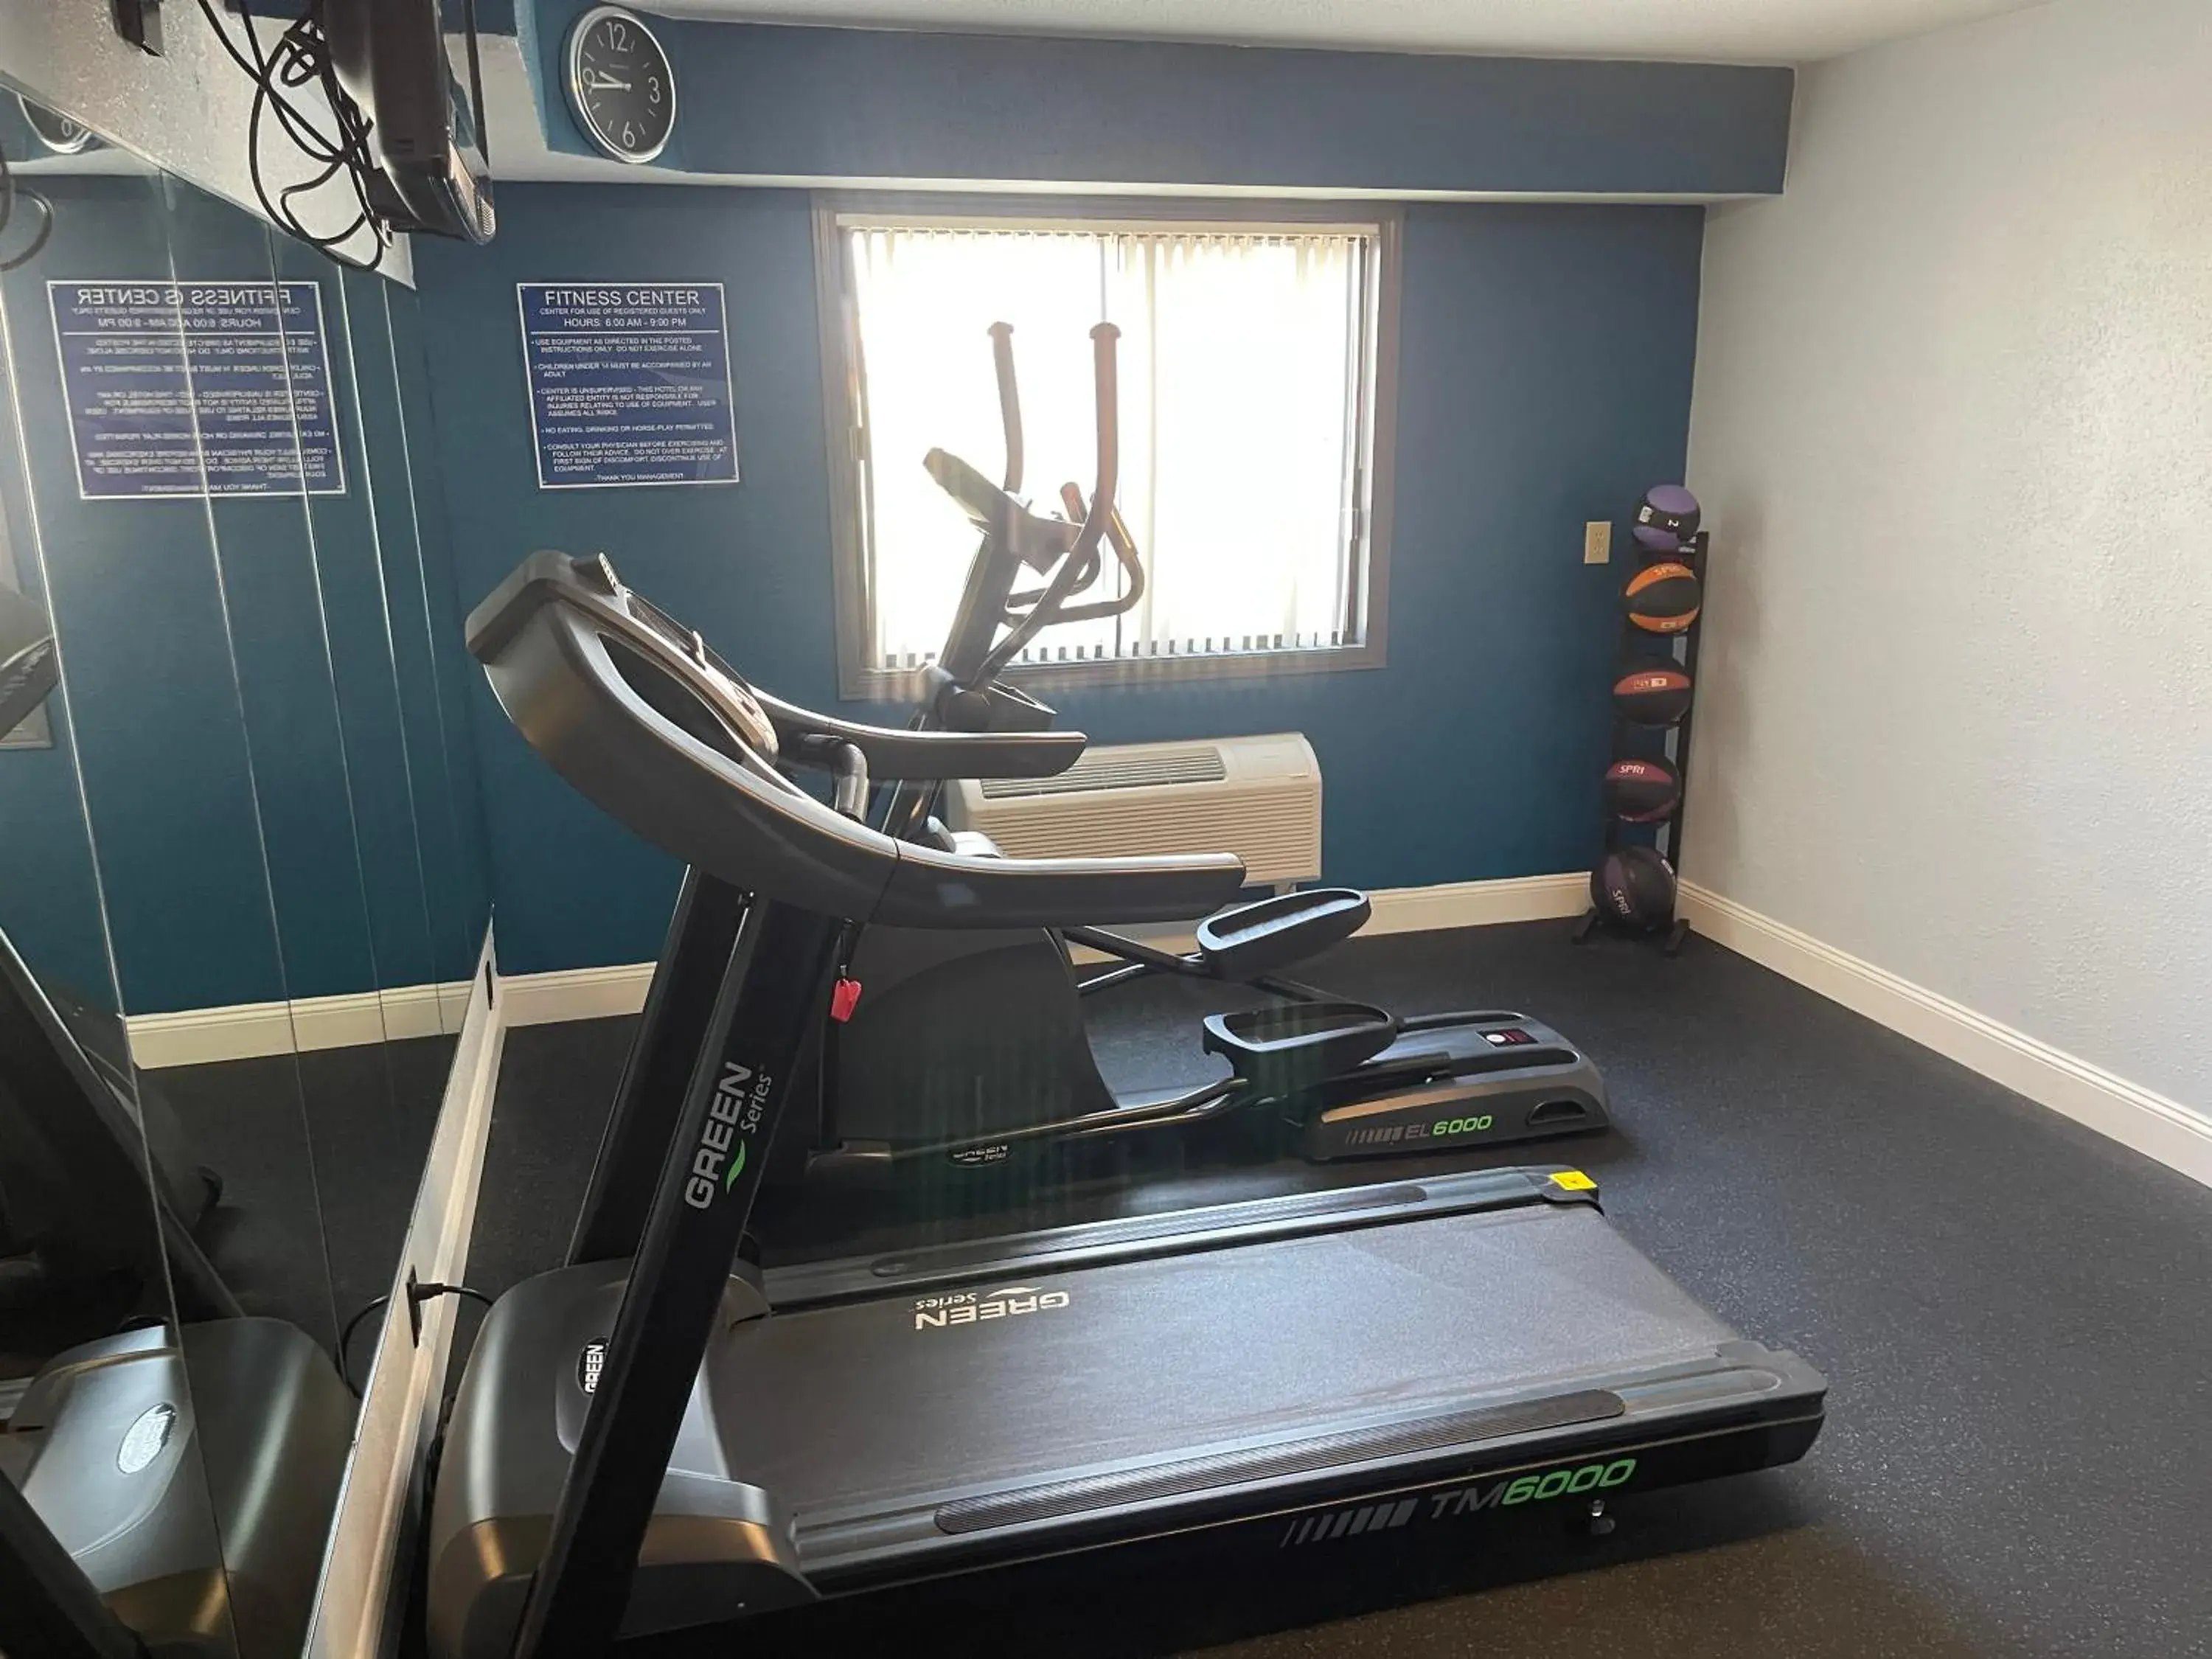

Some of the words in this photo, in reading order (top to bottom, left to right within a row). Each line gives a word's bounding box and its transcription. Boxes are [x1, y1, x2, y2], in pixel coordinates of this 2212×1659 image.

[606, 21, 627, 52] 12
[649, 76, 661, 103] 3
[622, 121, 636, 147] 6
[546, 290, 622, 305] FITNESS
[627, 290, 700, 305] CENTER
[613, 307, 658, 316] REGISTERED
[627, 318, 642, 327] AM
[650, 318, 669, 327] 9:00
[672, 318, 687, 327] PM
[1619, 765, 1645, 774] SPRI
[740, 1073, 772, 1134] Series
[684, 1060, 752, 1209] GREEN
[1405, 1115, 1492, 1138] EL6000
[915, 1293, 977, 1310] Series
[915, 1291, 1069, 1330] GREEN
[1430, 1458, 1637, 1519] TM6000
